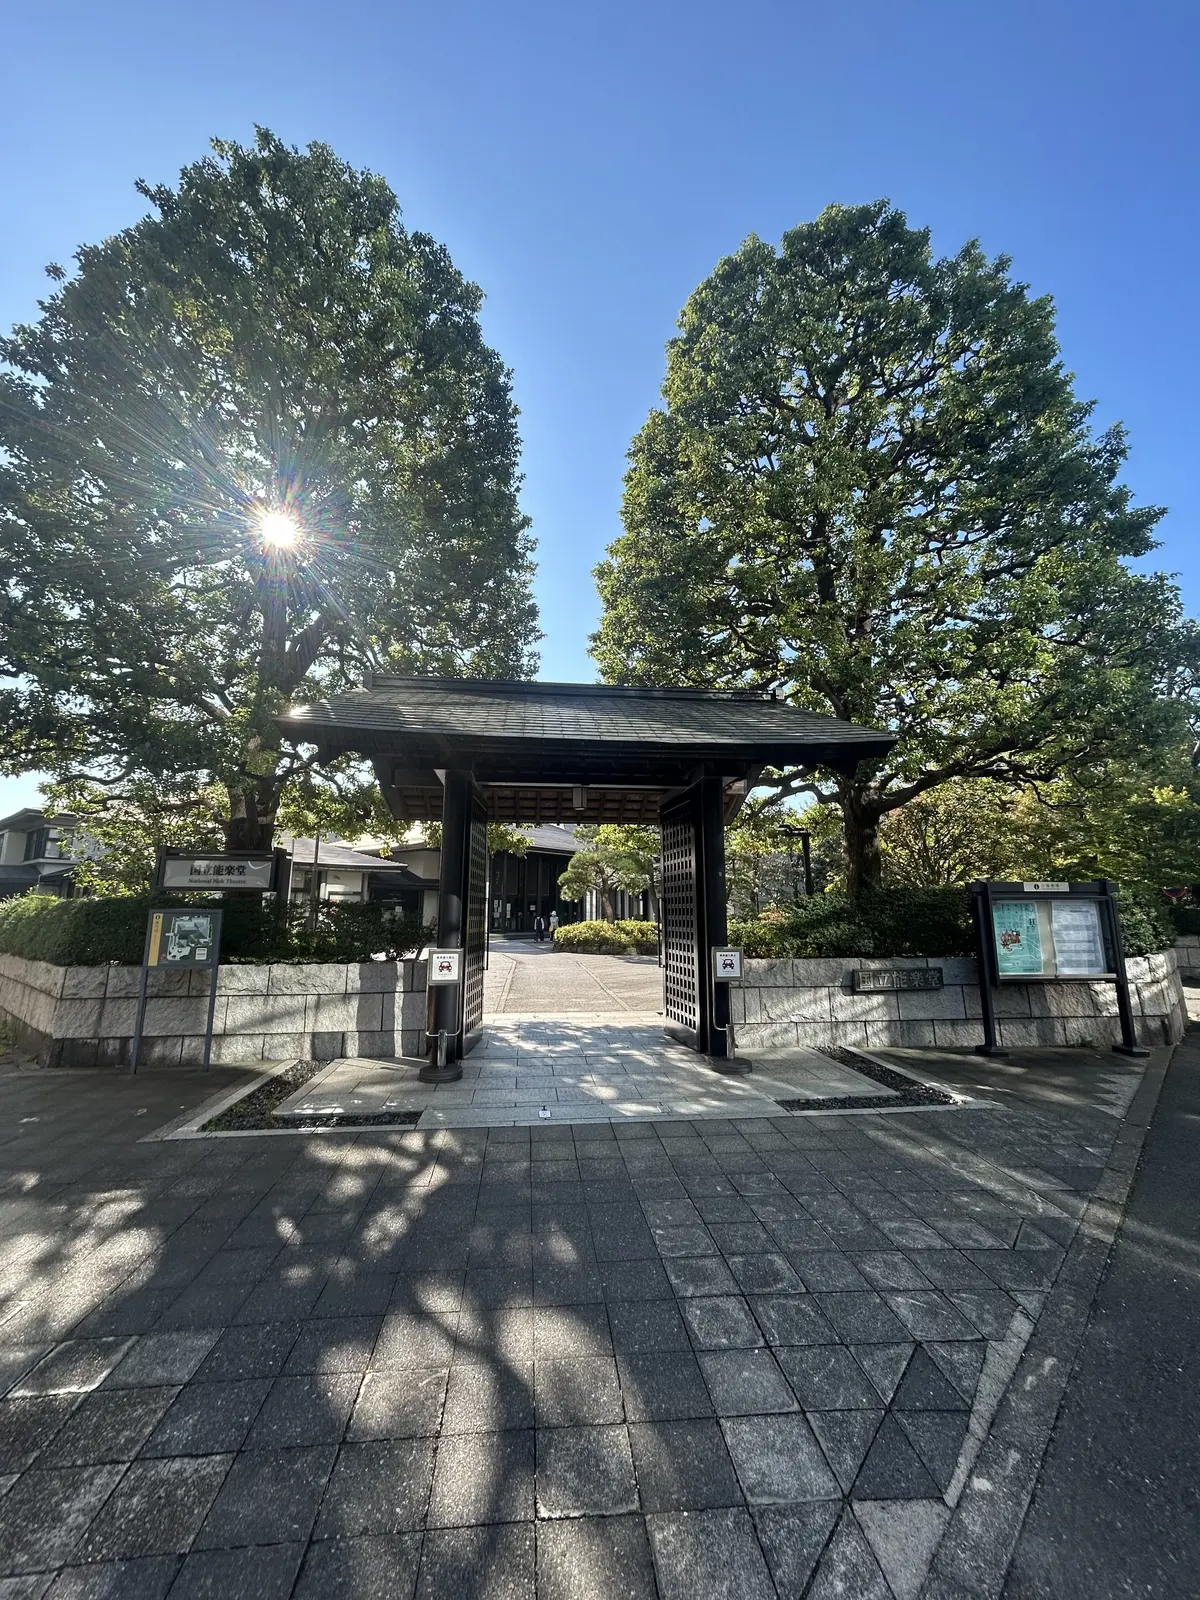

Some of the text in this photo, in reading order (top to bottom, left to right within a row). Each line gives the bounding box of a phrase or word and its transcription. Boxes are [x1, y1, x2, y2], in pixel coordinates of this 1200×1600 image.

[189, 864, 247, 876] 国立能楽堂
[859, 970, 941, 989] 国立能楽堂
